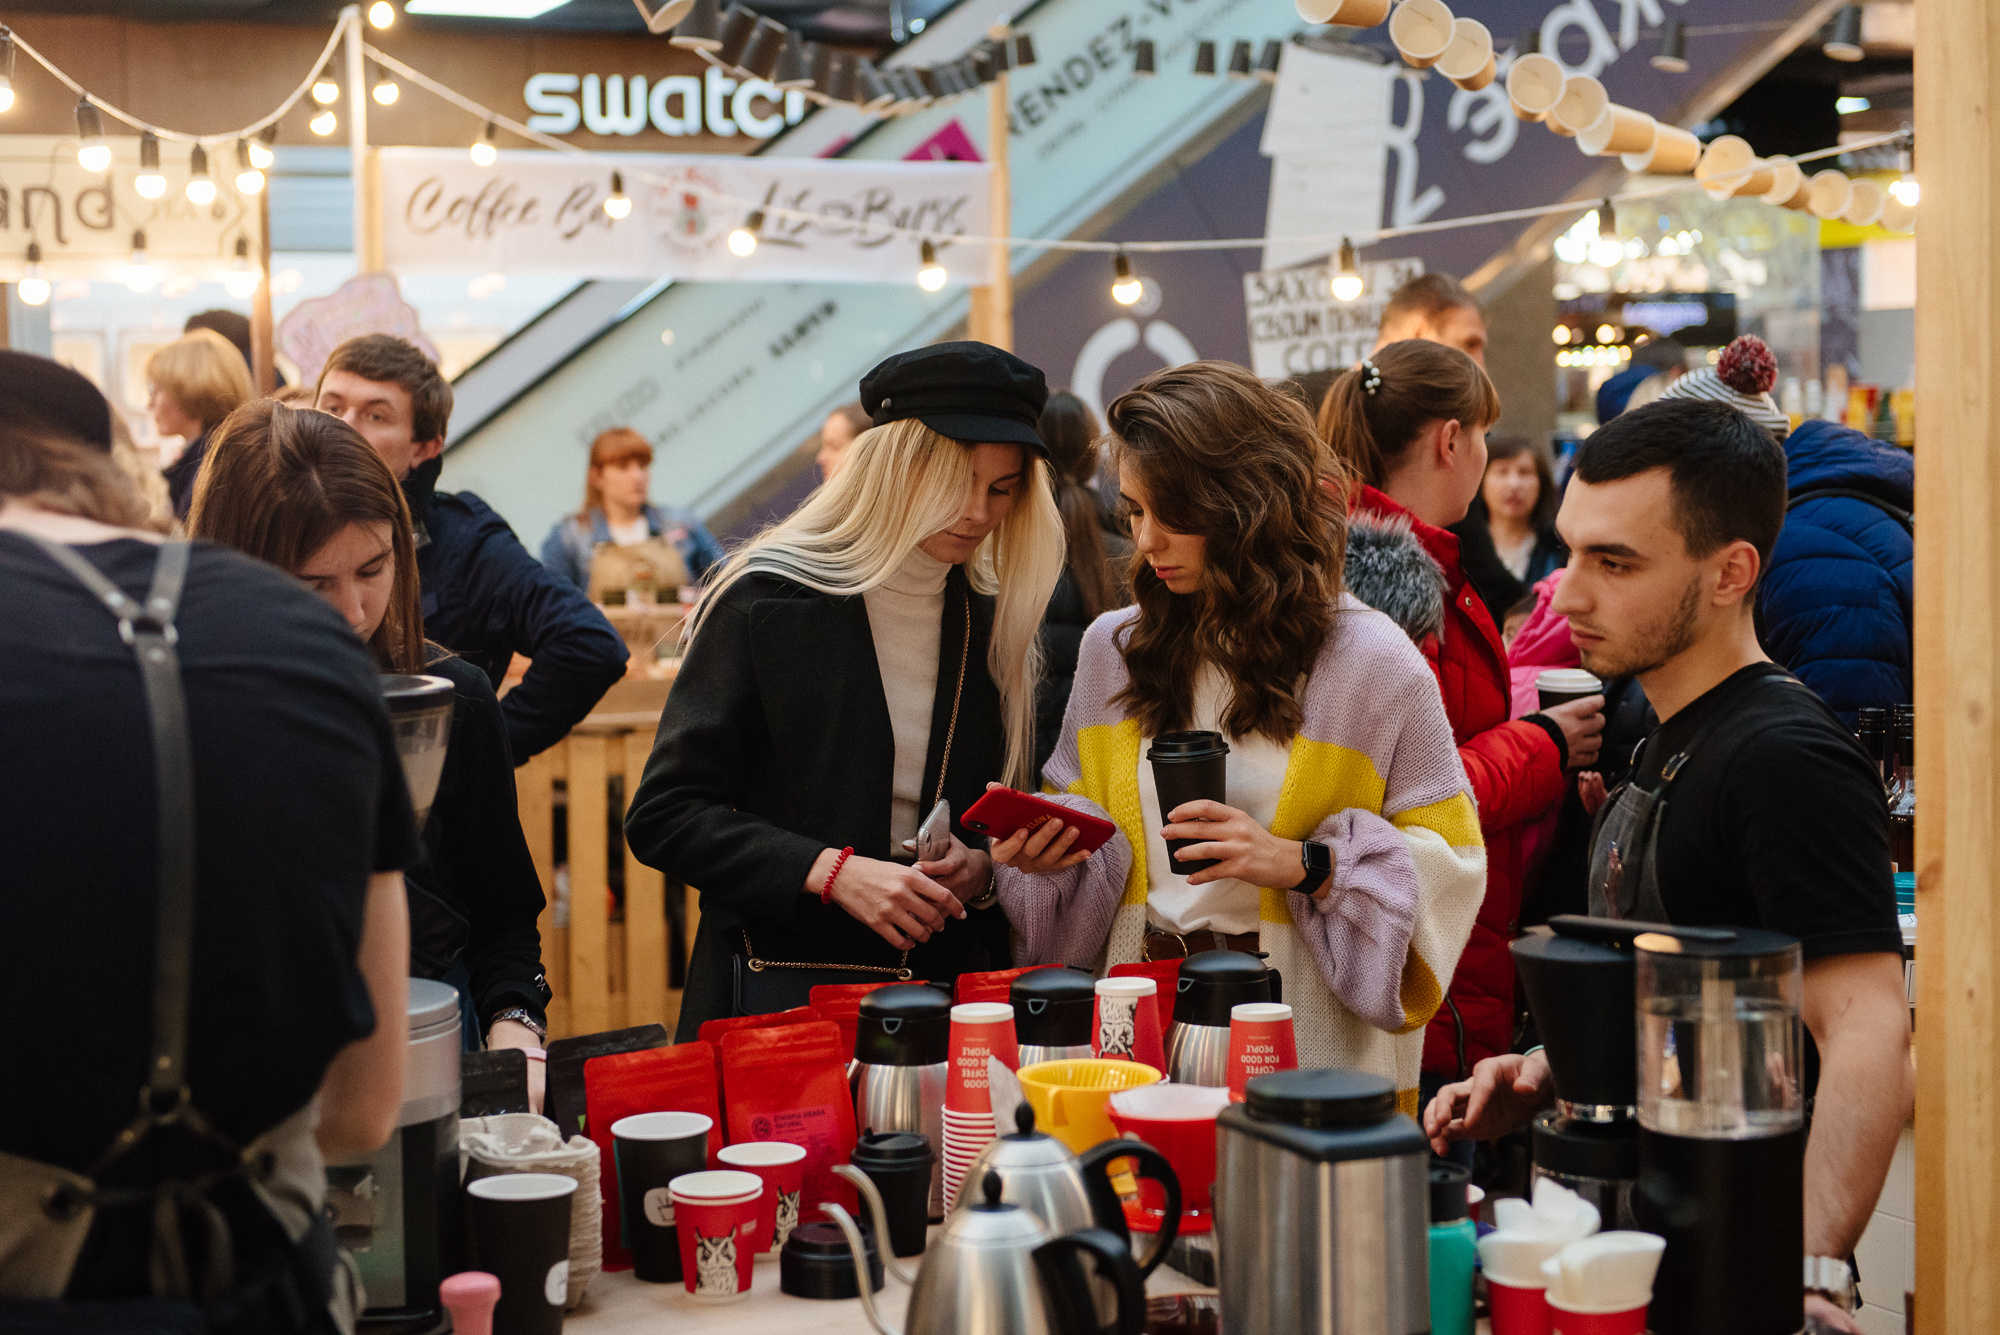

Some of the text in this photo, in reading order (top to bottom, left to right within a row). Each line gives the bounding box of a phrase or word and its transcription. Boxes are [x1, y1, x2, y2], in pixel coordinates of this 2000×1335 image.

[1008, 0, 1197, 137] ENDEZ-V
[0, 172, 115, 245] nd
[405, 174, 543, 240] Coffee
[553, 182, 615, 241] Ba
[962, 1047, 990, 1056] PEOPLE
[1246, 1044, 1274, 1053] PEOPLE
[957, 1057, 979, 1067] GOOD
[1241, 1055, 1280, 1063] FOR GOOD
[1246, 1065, 1275, 1074] COFFEE
[964, 1079, 989, 1088] GOOD
